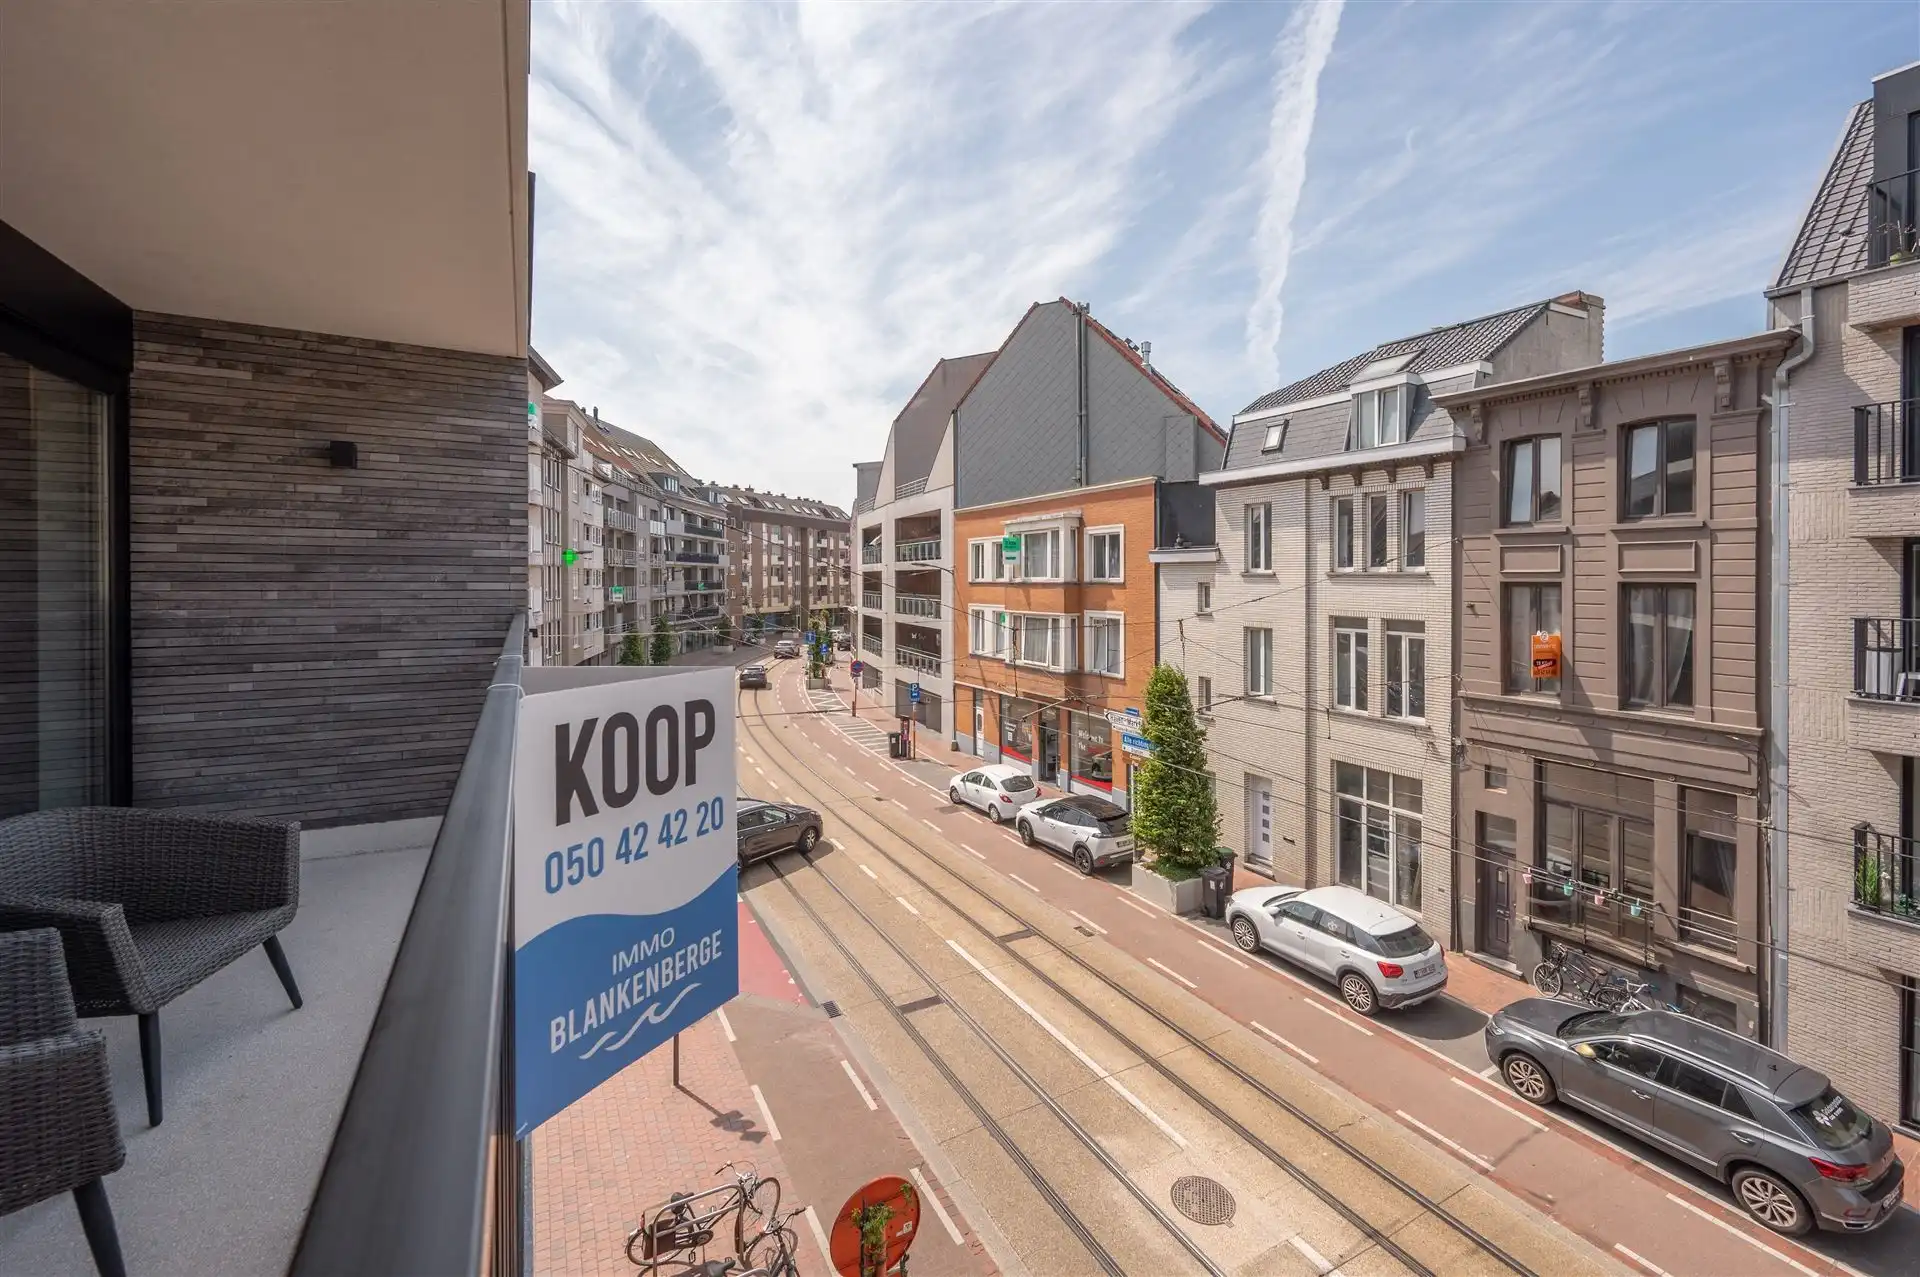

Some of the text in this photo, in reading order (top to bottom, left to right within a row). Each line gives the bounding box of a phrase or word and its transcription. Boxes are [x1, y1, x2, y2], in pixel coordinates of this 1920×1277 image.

[555, 698, 716, 827] KOOP
[1078, 730, 1098, 743] Welcme
[544, 796, 724, 894] 050 42 42 20
[550, 929, 722, 1054] BLANKENBERGE
[612, 927, 675, 976] IMMO
